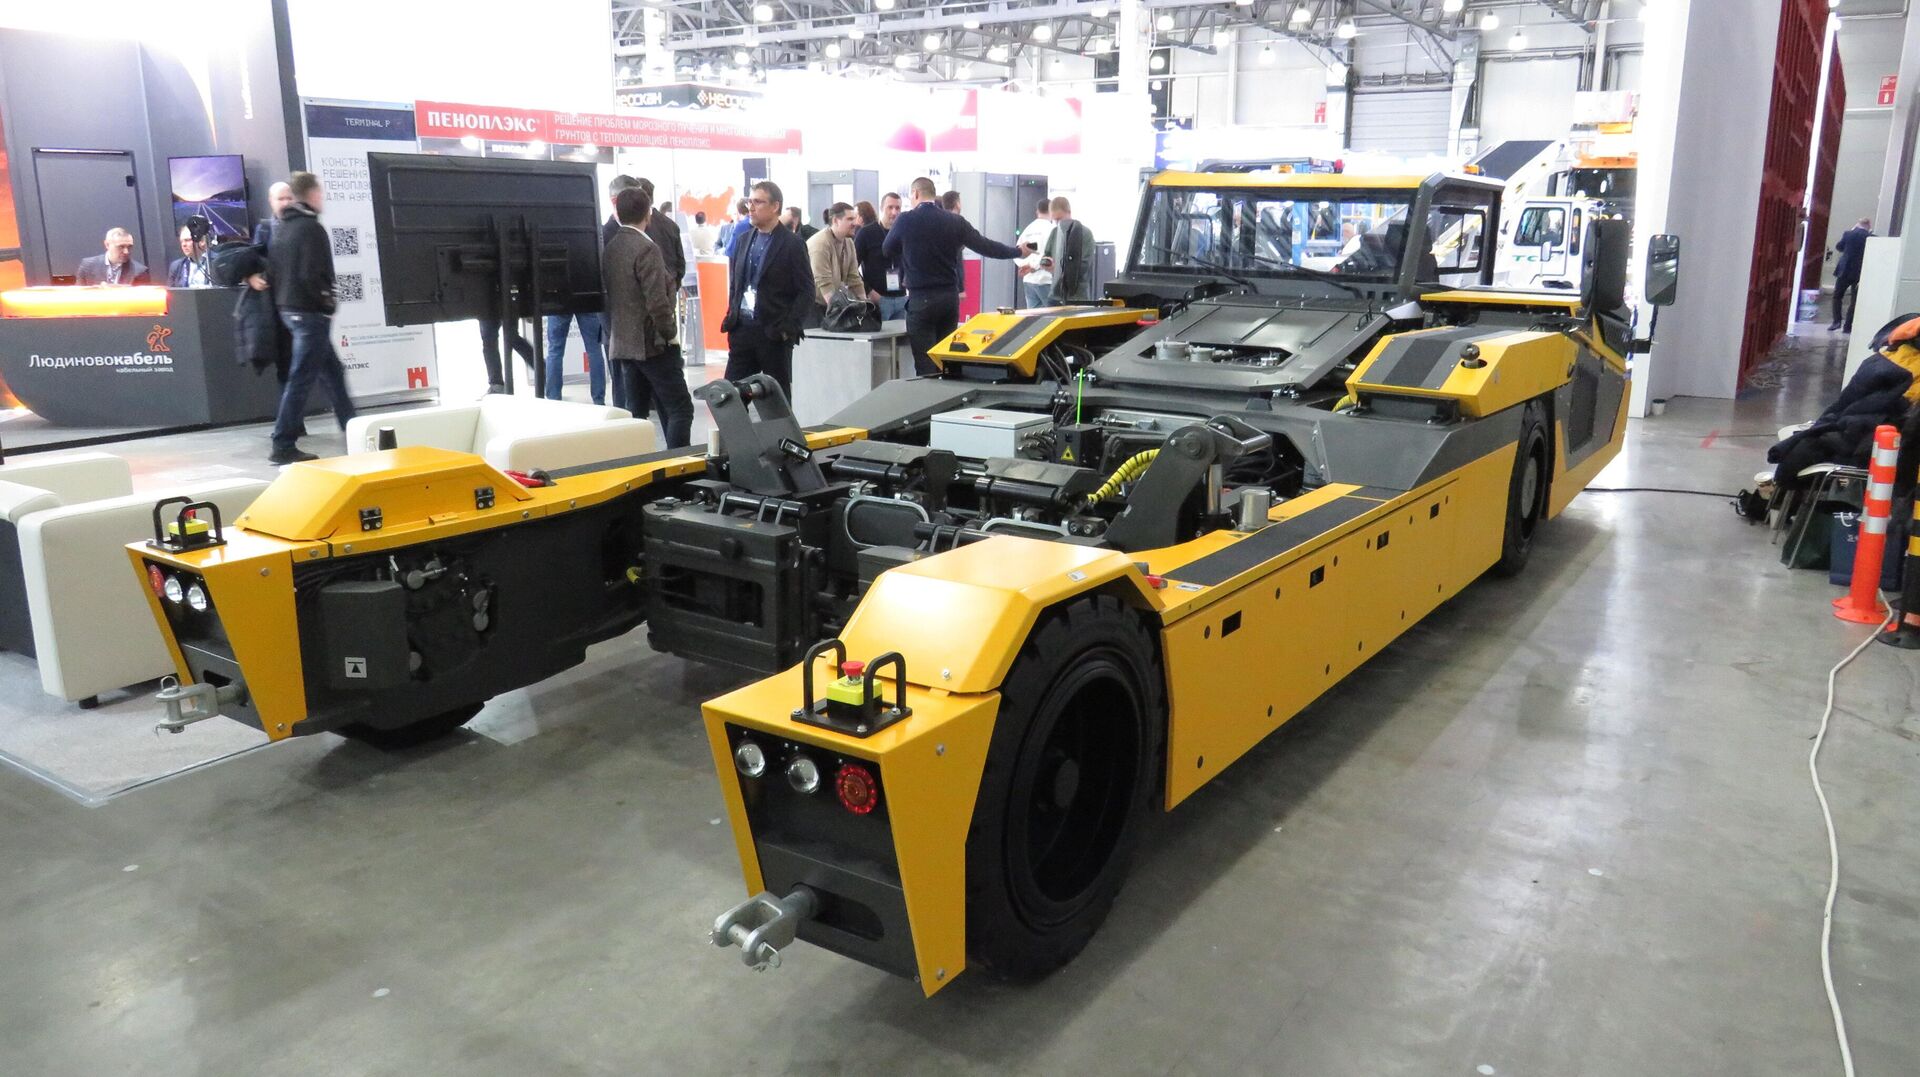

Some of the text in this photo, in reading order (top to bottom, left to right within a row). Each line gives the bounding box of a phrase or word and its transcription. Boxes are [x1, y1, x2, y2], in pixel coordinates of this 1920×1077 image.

[344, 117, 391, 128] TERMINAL P
[427, 111, 537, 132] ПЕНОПЛЭКС
[554, 114, 593, 127] РЕШЕНИЕ
[594, 117, 631, 129] ПРОБЛЕМ
[632, 119, 677, 132] МОРОЗНОГО
[555, 129, 591, 142] ГРУНТОВ
[592, 132, 599, 142] С
[600, 132, 668, 145] ТЕПЛОИЗОЛЯЦИЕЙ
[323, 169, 368, 179] РЕШЕНИЯ
[326, 192, 345, 201] ДЛЯ
[29, 352, 173, 369] Людиновокабель
